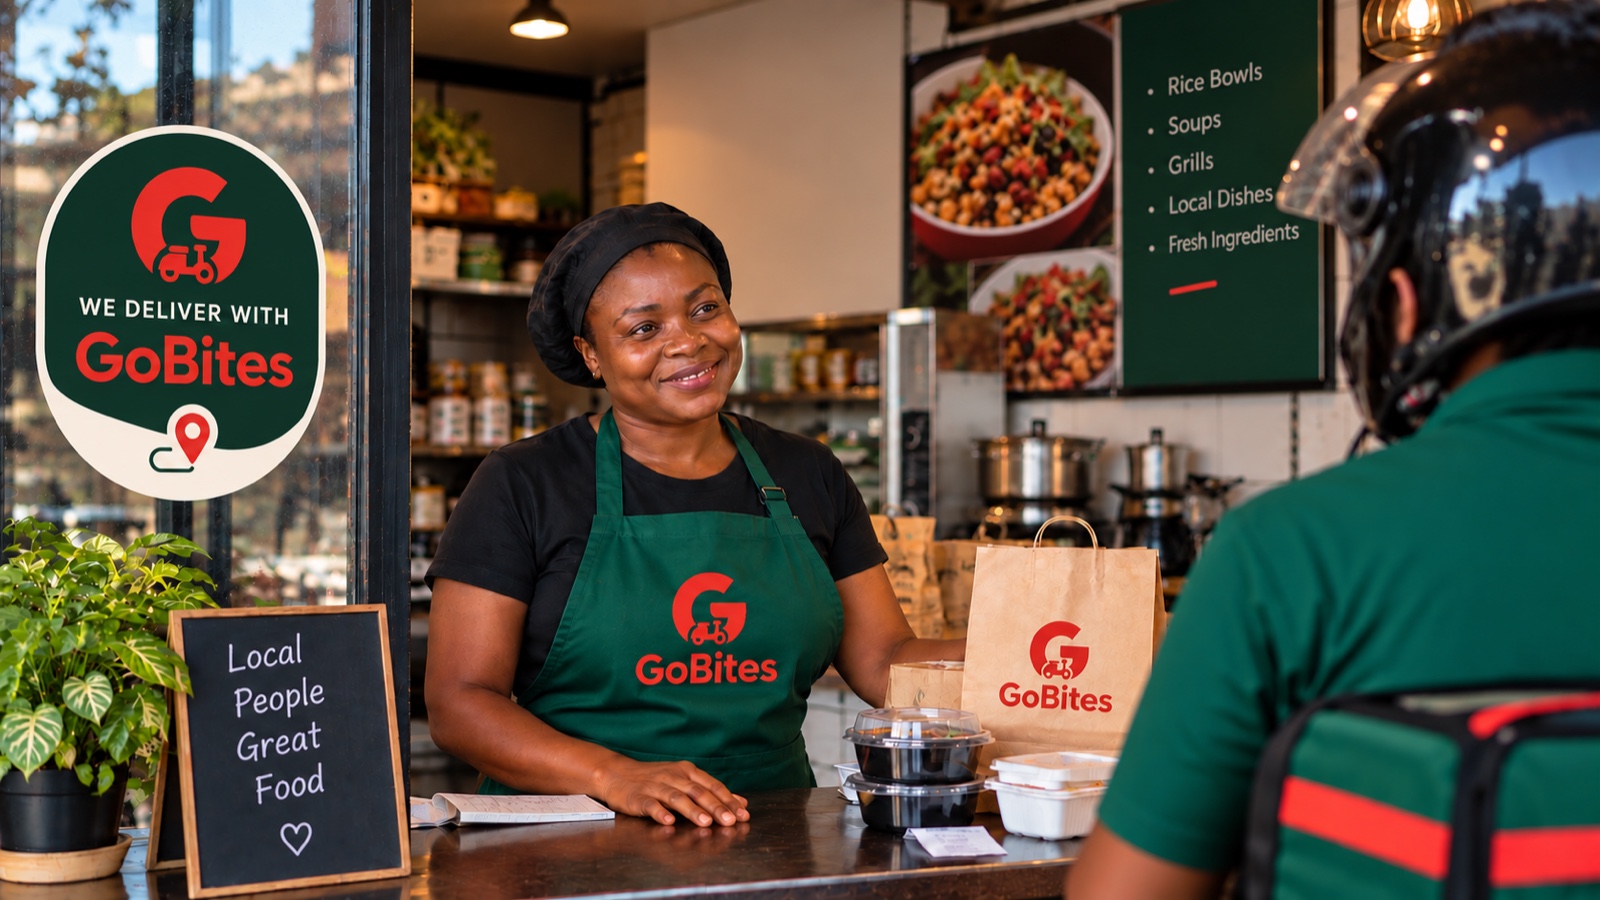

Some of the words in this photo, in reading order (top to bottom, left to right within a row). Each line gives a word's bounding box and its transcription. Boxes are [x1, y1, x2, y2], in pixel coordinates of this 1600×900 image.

[1168, 75, 1205, 96] Rice
[1210, 62, 1263, 88] Bowls
[1168, 113, 1222, 135] Soups
[1168, 151, 1214, 175] Grills
[1169, 190, 1212, 215] Local
[1217, 186, 1273, 209] Dishes
[131, 166, 247, 285] G
[1169, 232, 1208, 254] Fresh
[1211, 223, 1300, 252] Ingredients
[79, 297, 116, 317] WE
[125, 299, 221, 323] DELIVER
[231, 304, 289, 325] WITH
[75, 331, 294, 388] GoBites
[671, 571, 747, 646] G
[228, 632, 302, 673] Local
[635, 651, 778, 686] GoBites
[1029, 620, 1090, 680] G
[233, 676, 325, 718] People
[999, 681, 1113, 713] GoBites
[236, 721, 322, 762] Great
[255, 762, 325, 805] Food
